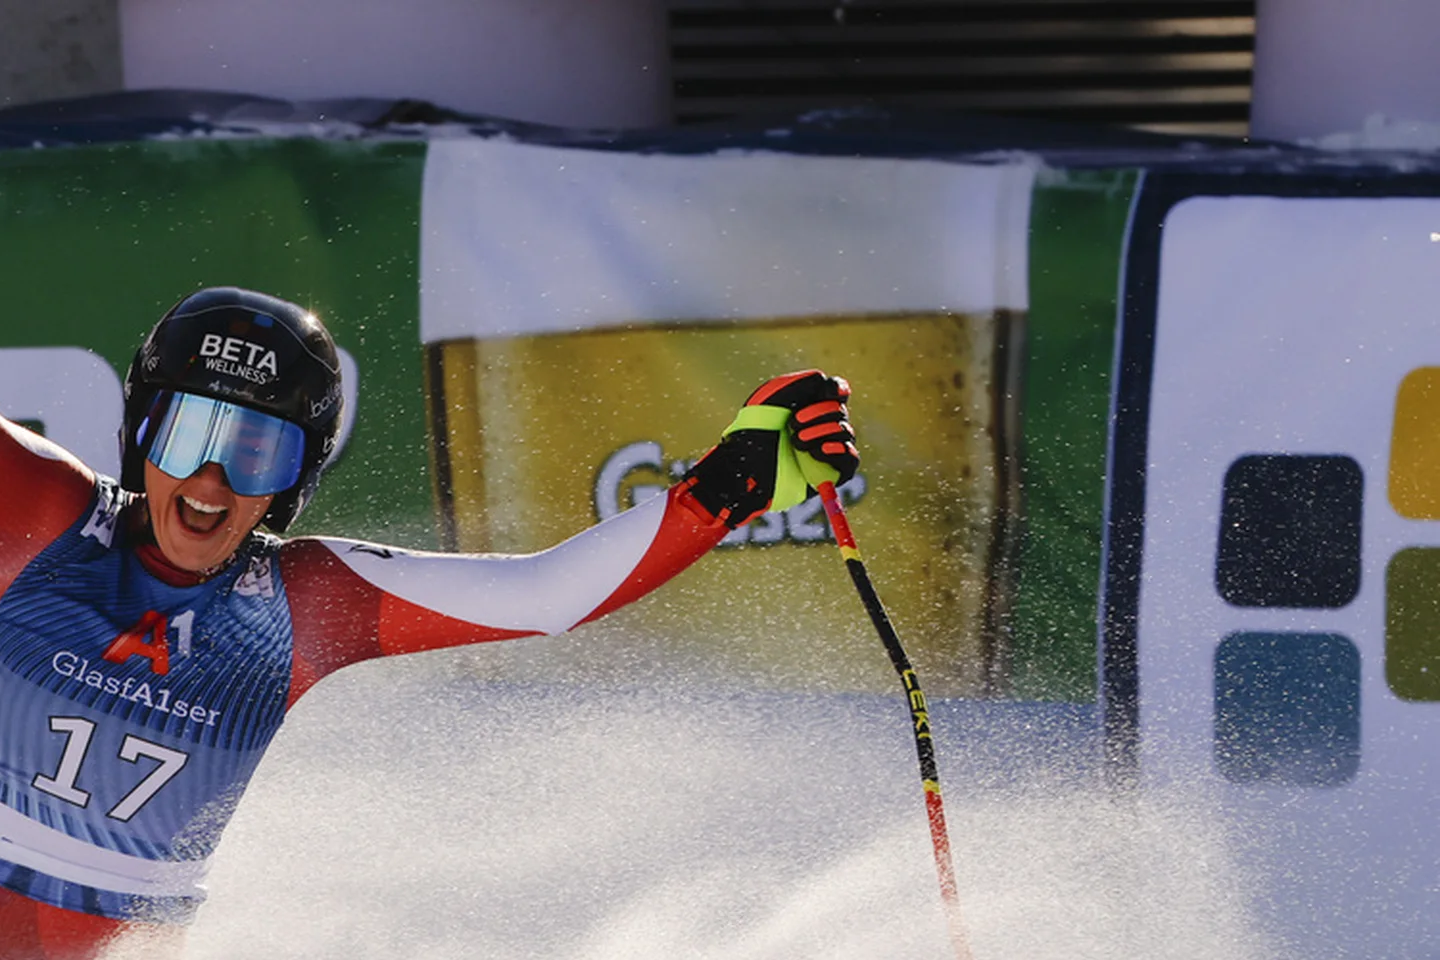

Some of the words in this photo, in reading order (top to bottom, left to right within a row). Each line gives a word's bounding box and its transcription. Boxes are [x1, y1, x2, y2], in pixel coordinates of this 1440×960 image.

[200, 333, 277, 376] BETA
[205, 357, 268, 385] WELLNESS
[101, 609, 194, 676] A1
[52, 651, 220, 727] GlasfA1ser
[903, 669, 931, 739] LEKI
[31, 716, 190, 822] 17
